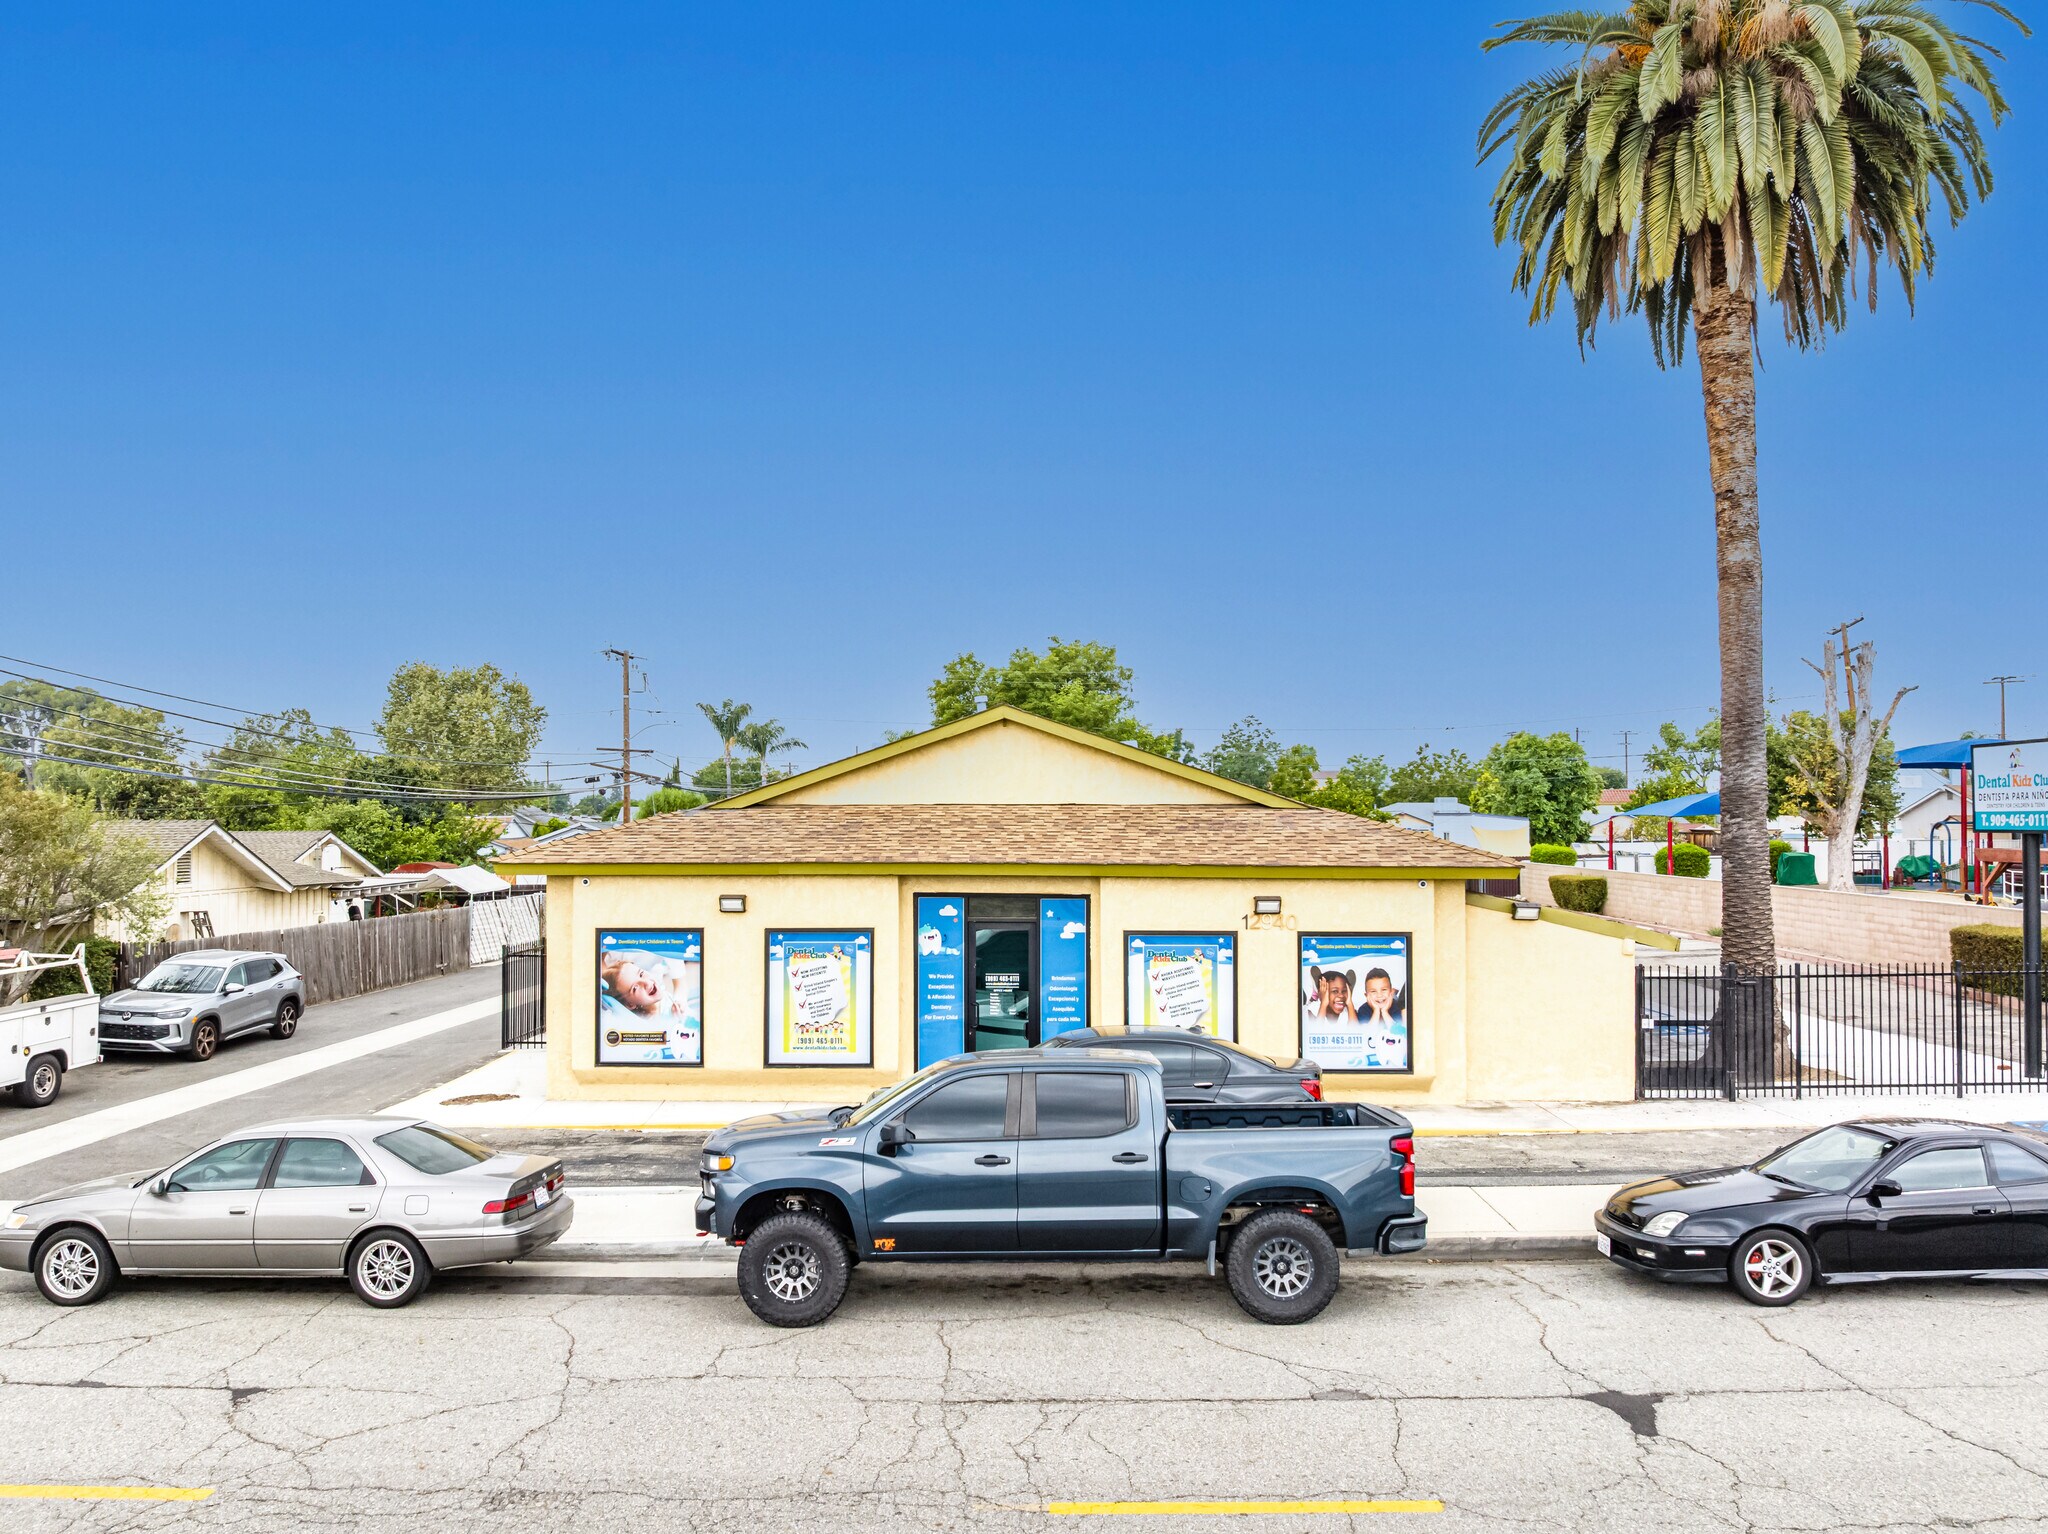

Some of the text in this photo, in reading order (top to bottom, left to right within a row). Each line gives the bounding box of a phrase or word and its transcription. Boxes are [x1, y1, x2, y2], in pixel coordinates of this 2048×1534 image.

[1978, 774, 2010, 788] Dental
[2012, 774, 2032, 787] Kidz
[1978, 792, 2009, 801] DENTISTA
[2012, 791, 2029, 800] PARA
[1981, 814, 1989, 826] T.
[1241, 914, 1297, 930] 12940
[787, 947, 815, 955] Dental
[1308, 1036, 1363, 1045] (909) 465-0111
[874, 1239, 895, 1251] FOX
